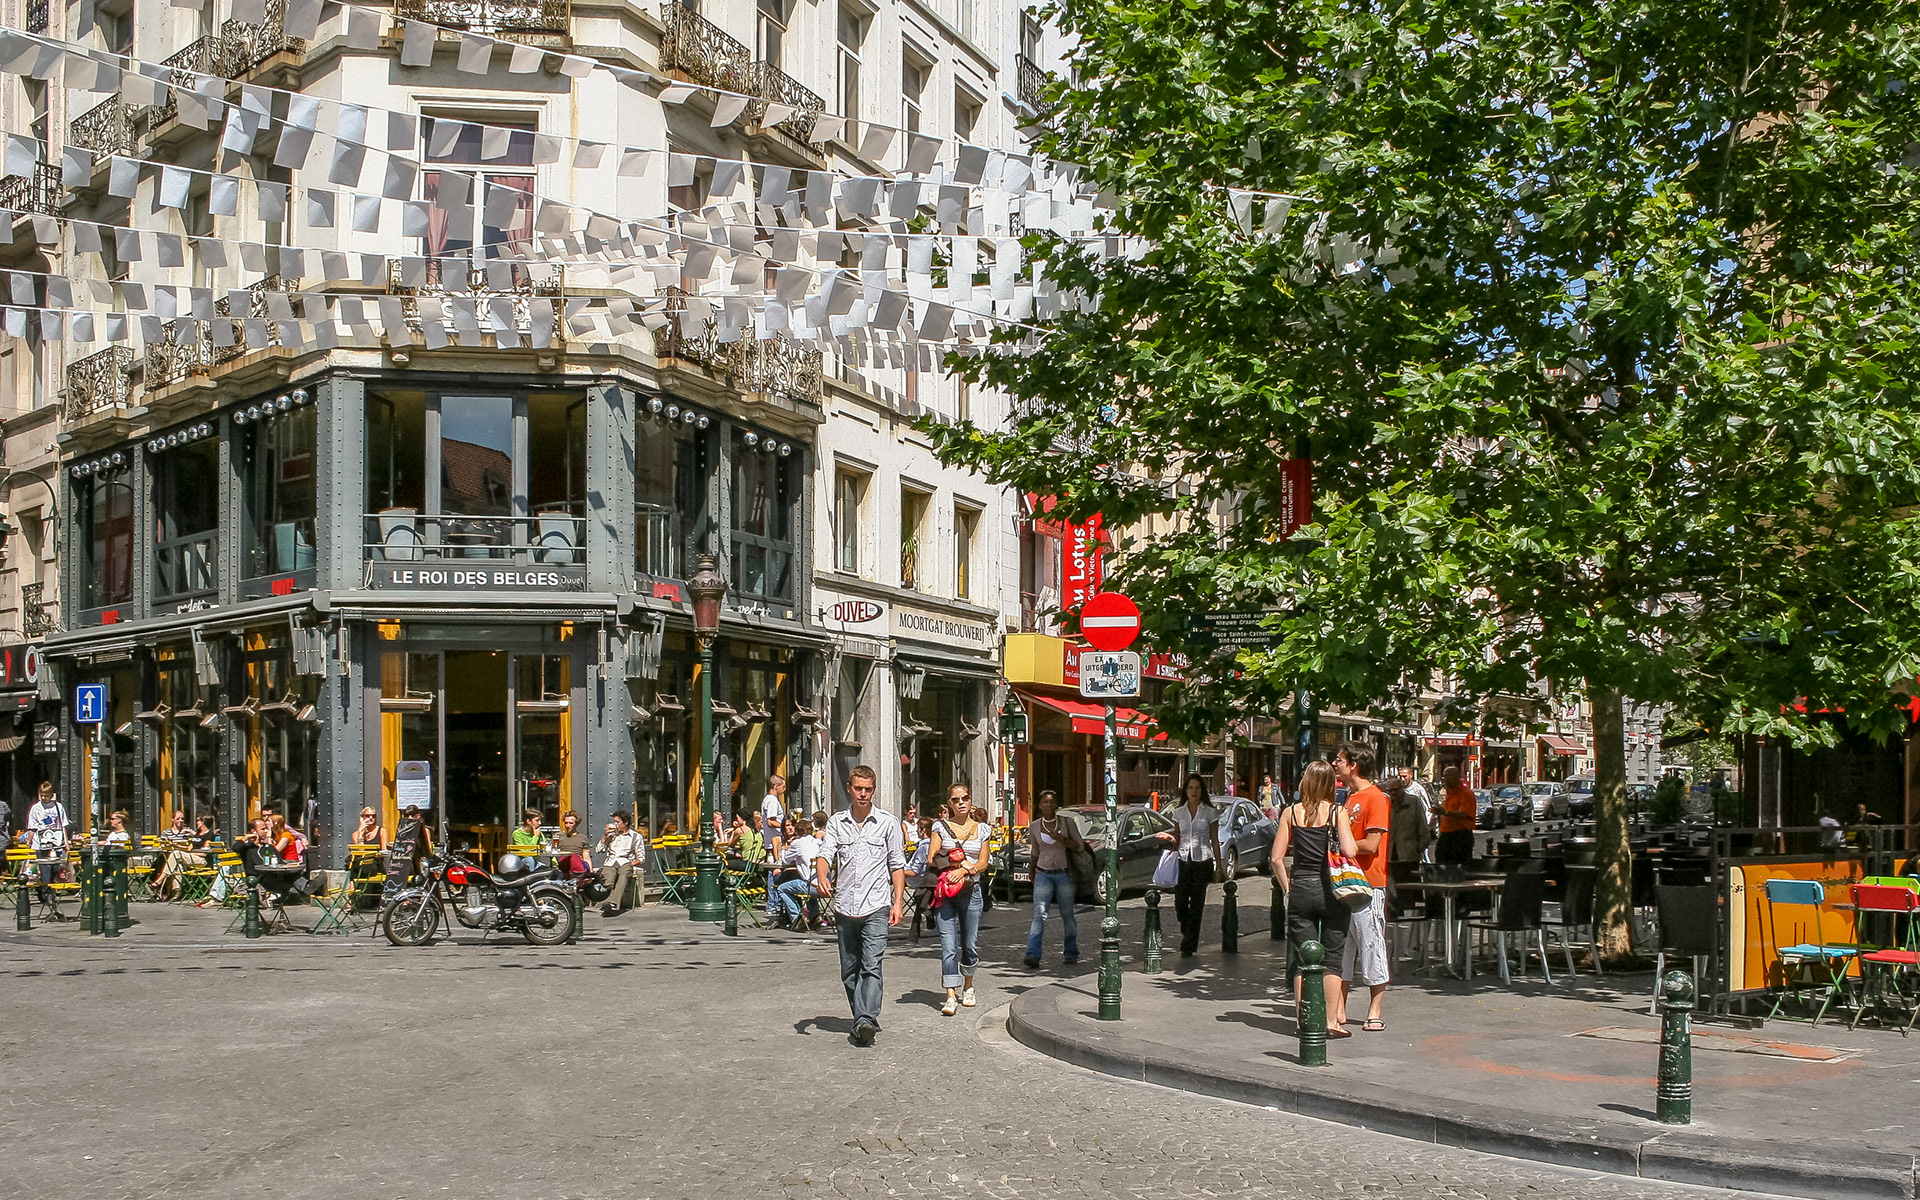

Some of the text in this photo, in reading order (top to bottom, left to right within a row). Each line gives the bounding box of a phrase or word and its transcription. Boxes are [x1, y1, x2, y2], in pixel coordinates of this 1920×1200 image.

[1281, 495, 1287, 505] du
[1069, 528, 1086, 581] Lotus
[1087, 526, 1095, 575] Vietnnne
[392, 570, 559, 586] LE ROI DES BELGES
[834, 601, 872, 622] DUVEL
[899, 612, 985, 644] MOORTGAT BROUWERIJ
[1065, 649, 1077, 667] Au
[1085, 664, 1134, 672] UITGEDERD
